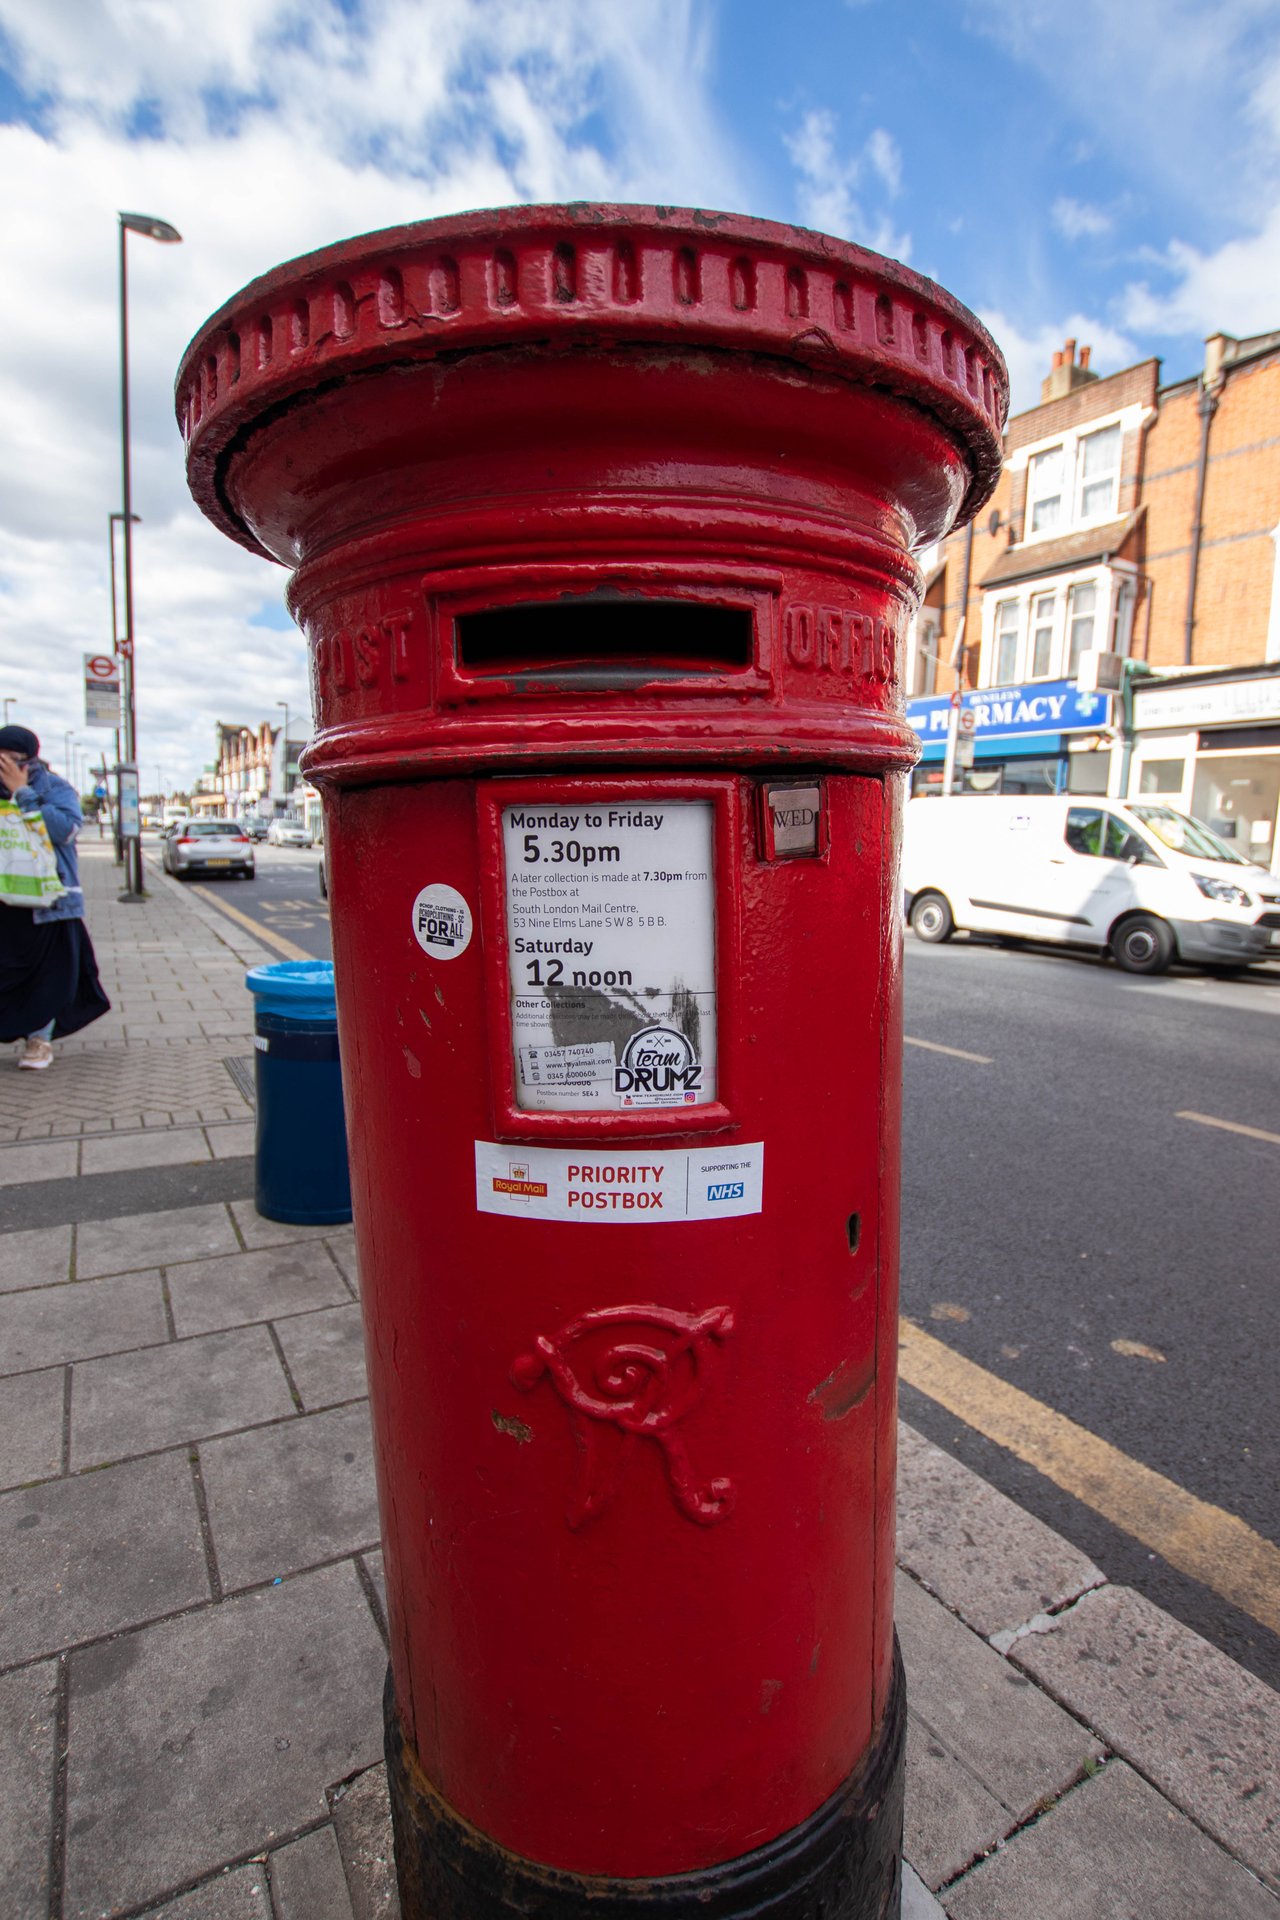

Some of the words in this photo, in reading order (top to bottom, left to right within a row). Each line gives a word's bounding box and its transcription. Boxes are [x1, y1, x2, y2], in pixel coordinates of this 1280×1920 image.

[510, 812, 580, 831] Monday
[584, 813, 602, 828] to
[608, 811, 664, 830] Friday
[774, 808, 814, 829] WED
[523, 834, 621, 867] 5.30pm
[511, 873, 519, 883] A
[520, 873, 542, 883] later
[544, 872, 589, 883] collection
[591, 872, 599, 882] is
[602, 872, 629, 882] made
[631, 872, 641, 882] at
[643, 871, 683, 883] 7.30pm
[685, 870, 708, 881] from
[512, 886, 527, 897] the
[529, 886, 568, 897] Postbox
[570, 887, 579, 896] at
[512, 904, 541, 914] South
[543, 904, 579, 914] London
[581, 903, 602, 913] Mail
[604, 903, 639, 914] Centre,
[513, 918, 526, 928] 53
[528, 918, 551, 928] Nine
[553, 917, 577, 928] Elms
[579, 917, 603, 927] Lane
[514, 938, 594, 956] Saturday
[526, 959, 564, 986] 12
[572, 970, 632, 986] noon
[515, 1000, 539, 1009] Other
[540, 1000, 586, 1009] Collections
[515, 1012, 545, 1020] Additional
[544, 1049, 566, 1058] 03457
[567, 1047, 594, 1057] 740740
[636, 1048, 680, 1067] team
[545, 1057, 612, 1069] www.royalmail.com
[547, 1072, 564, 1080] 0345
[566, 1070, 597, 1079] 6000606
[615, 1066, 702, 1092] DRUMZ
[701, 1163, 739, 1173] SUPPORTING
[740, 1161, 751, 1169] THE
[567, 1165, 665, 1184] PRIORITY
[495, 1180, 522, 1192] Royal
[523, 1183, 545, 1193] Mail
[708, 1183, 743, 1200] NHS
[567, 1191, 664, 1210] POSTBOX
